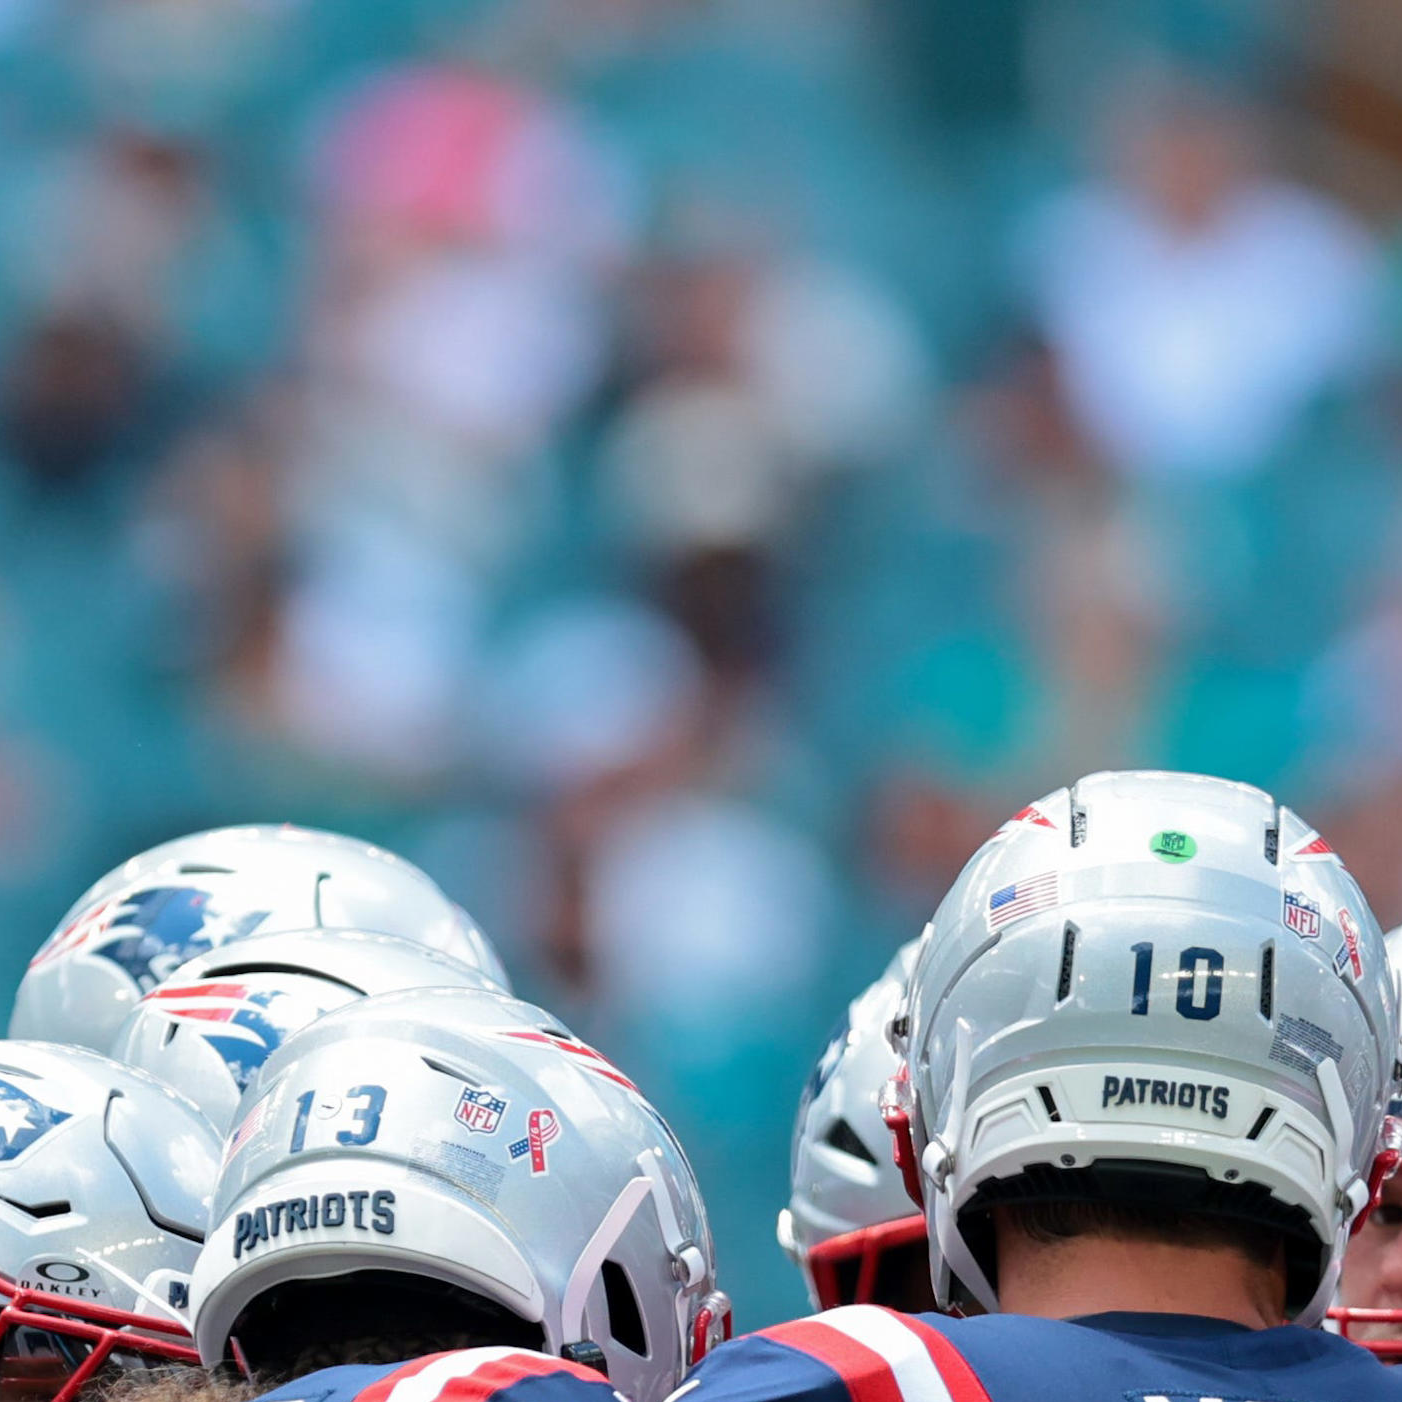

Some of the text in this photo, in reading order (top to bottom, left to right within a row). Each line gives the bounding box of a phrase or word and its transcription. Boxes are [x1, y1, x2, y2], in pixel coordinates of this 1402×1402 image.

[1285, 907, 1318, 937] NFL
[1130, 941, 1224, 1021] 10
[290, 1085, 387, 1153] 13
[459, 1101, 493, 1131] NFL
[1102, 1075, 1230, 1120] PATRIOTS
[529, 1125, 542, 1152] 9/11
[233, 1189, 396, 1260] PATRIOTS
